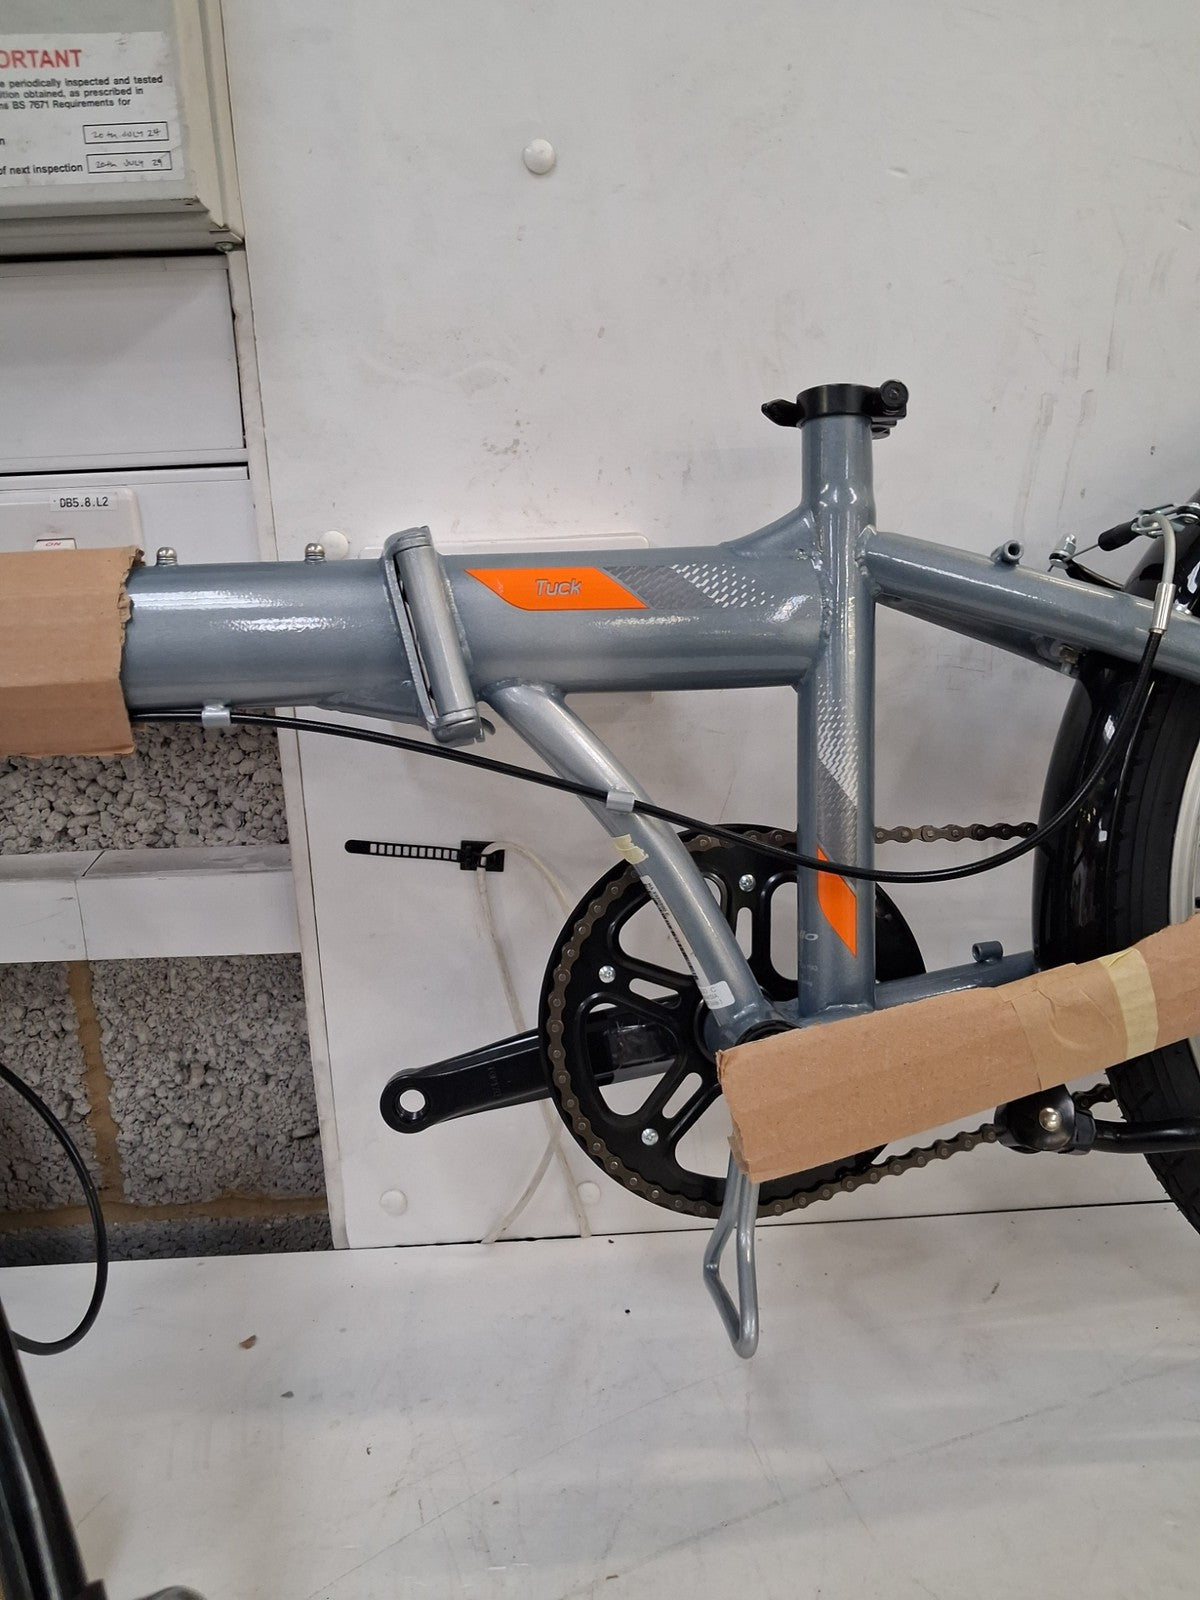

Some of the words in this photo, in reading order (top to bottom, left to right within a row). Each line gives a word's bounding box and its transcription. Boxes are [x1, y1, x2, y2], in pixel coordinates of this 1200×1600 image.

[9, 78, 62, 89] periodically
[65, 77, 110, 88] inspected
[113, 76, 131, 86] and
[133, 75, 163, 85] tested
[23, 89, 66, 98] obtained,
[69, 89, 80, 97] as
[83, 87, 132, 98] prescribed
[135, 87, 144, 95] in
[12, 100, 26, 110] BS
[29, 99, 50, 109] 7671
[52, 98, 115, 109] Requirements
[118, 98, 132, 107] for
[9, 164, 31, 175] next
[32, 163, 84, 175] inspection
[59, 496, 109, 508] DB5.8.L2
[535, 578, 583, 597] Tuck
